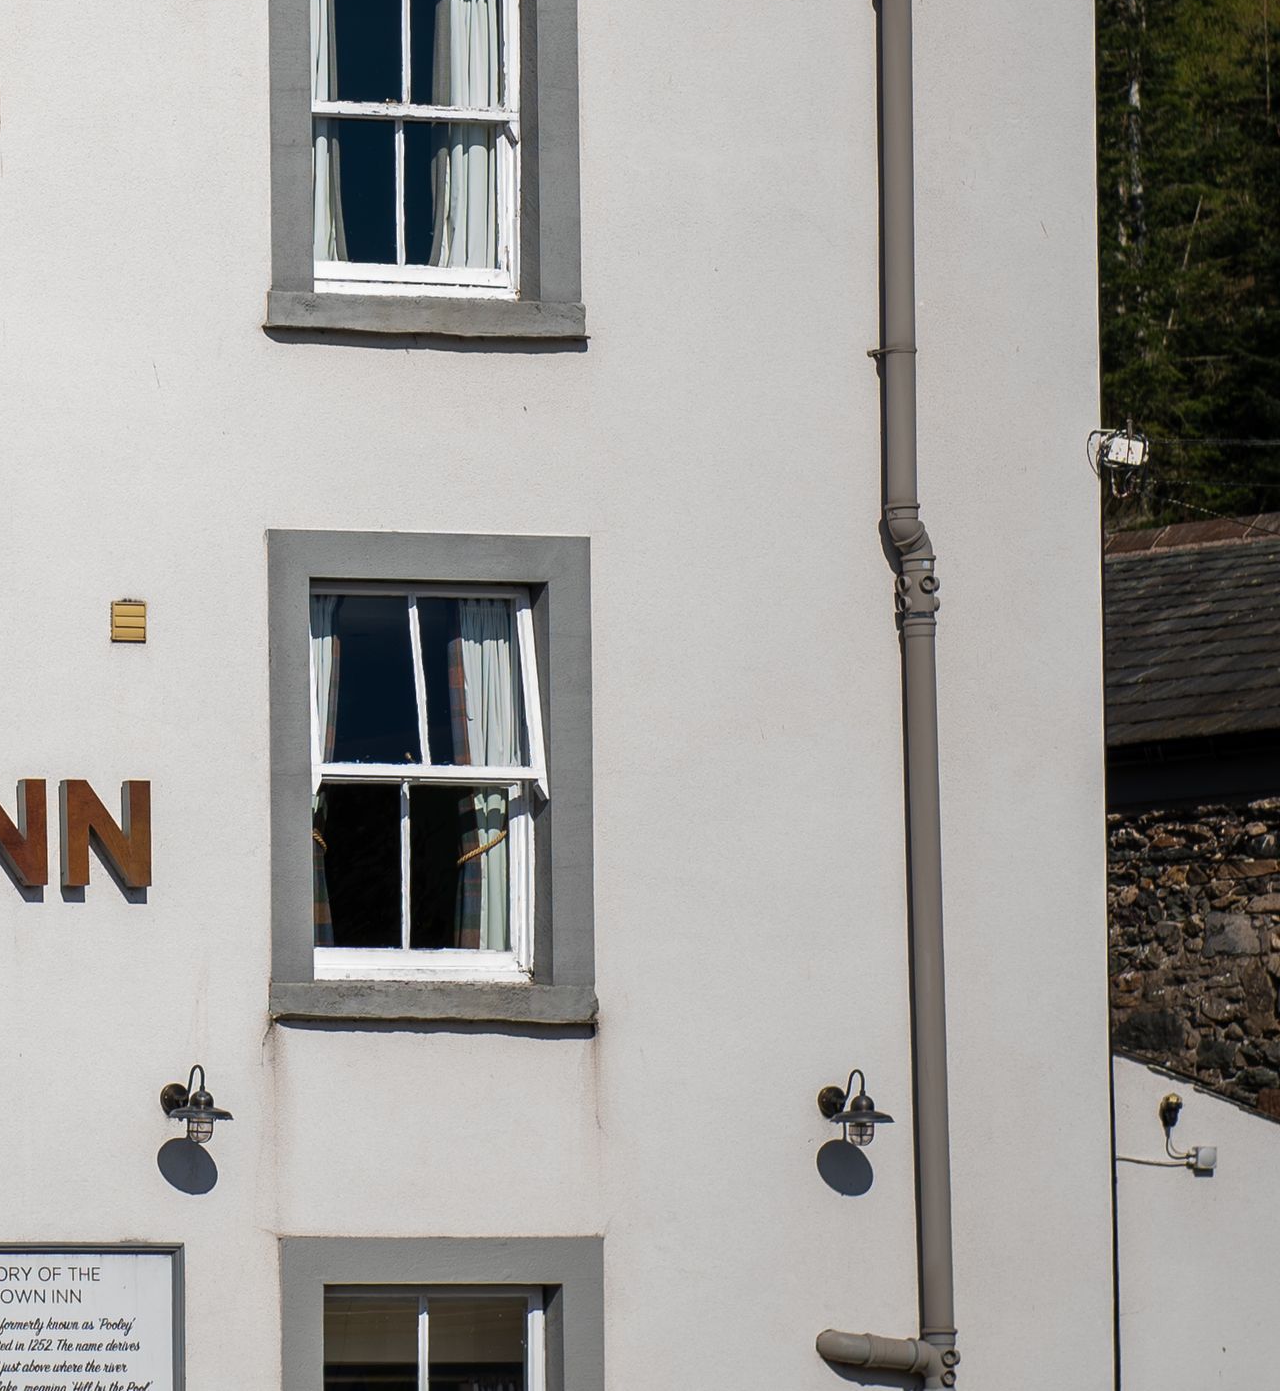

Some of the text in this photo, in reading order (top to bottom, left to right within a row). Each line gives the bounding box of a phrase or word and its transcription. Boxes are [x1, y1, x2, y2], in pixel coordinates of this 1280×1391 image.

[37, 1266, 62, 1282] OF
[67, 1266, 101, 1282] THE
[51, 1289, 82, 1304] INN
[45, 1316, 80, 1331] known
[81, 1320, 95, 1331] as
[14, 1340, 25, 1352] in
[56, 1338, 75, 1352] The
[75, 1341, 104, 1352] name
[104, 1338, 141, 1352] derives
[21, 1359, 52, 1373] above
[52, 1359, 84, 1373] where
[84, 1359, 102, 1373] the
[102, 1360, 128, 1373] river
